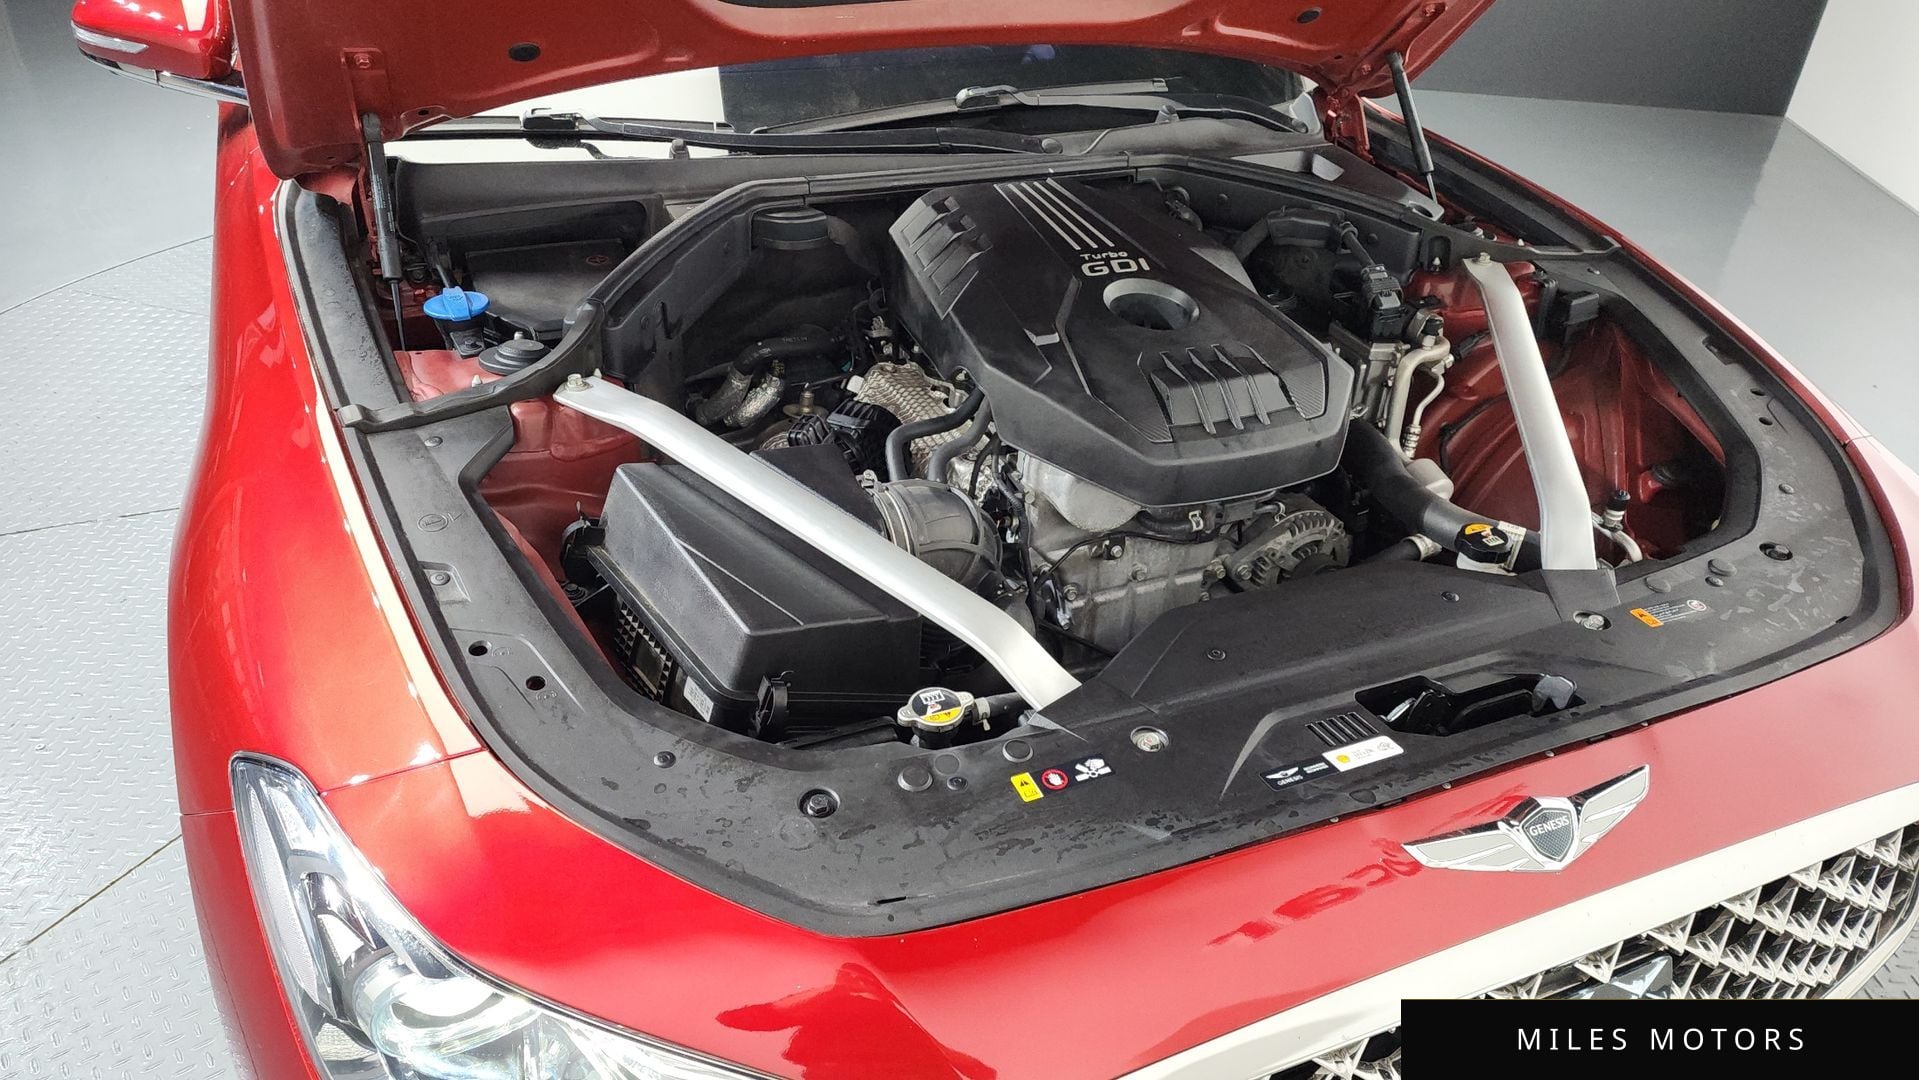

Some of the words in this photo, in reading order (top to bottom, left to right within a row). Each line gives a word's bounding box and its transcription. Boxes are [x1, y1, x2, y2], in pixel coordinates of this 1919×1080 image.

[1080, 251, 1128, 261] Turbo
[1081, 257, 1151, 277] GDI
[1529, 815, 1570, 836] GENESIS
